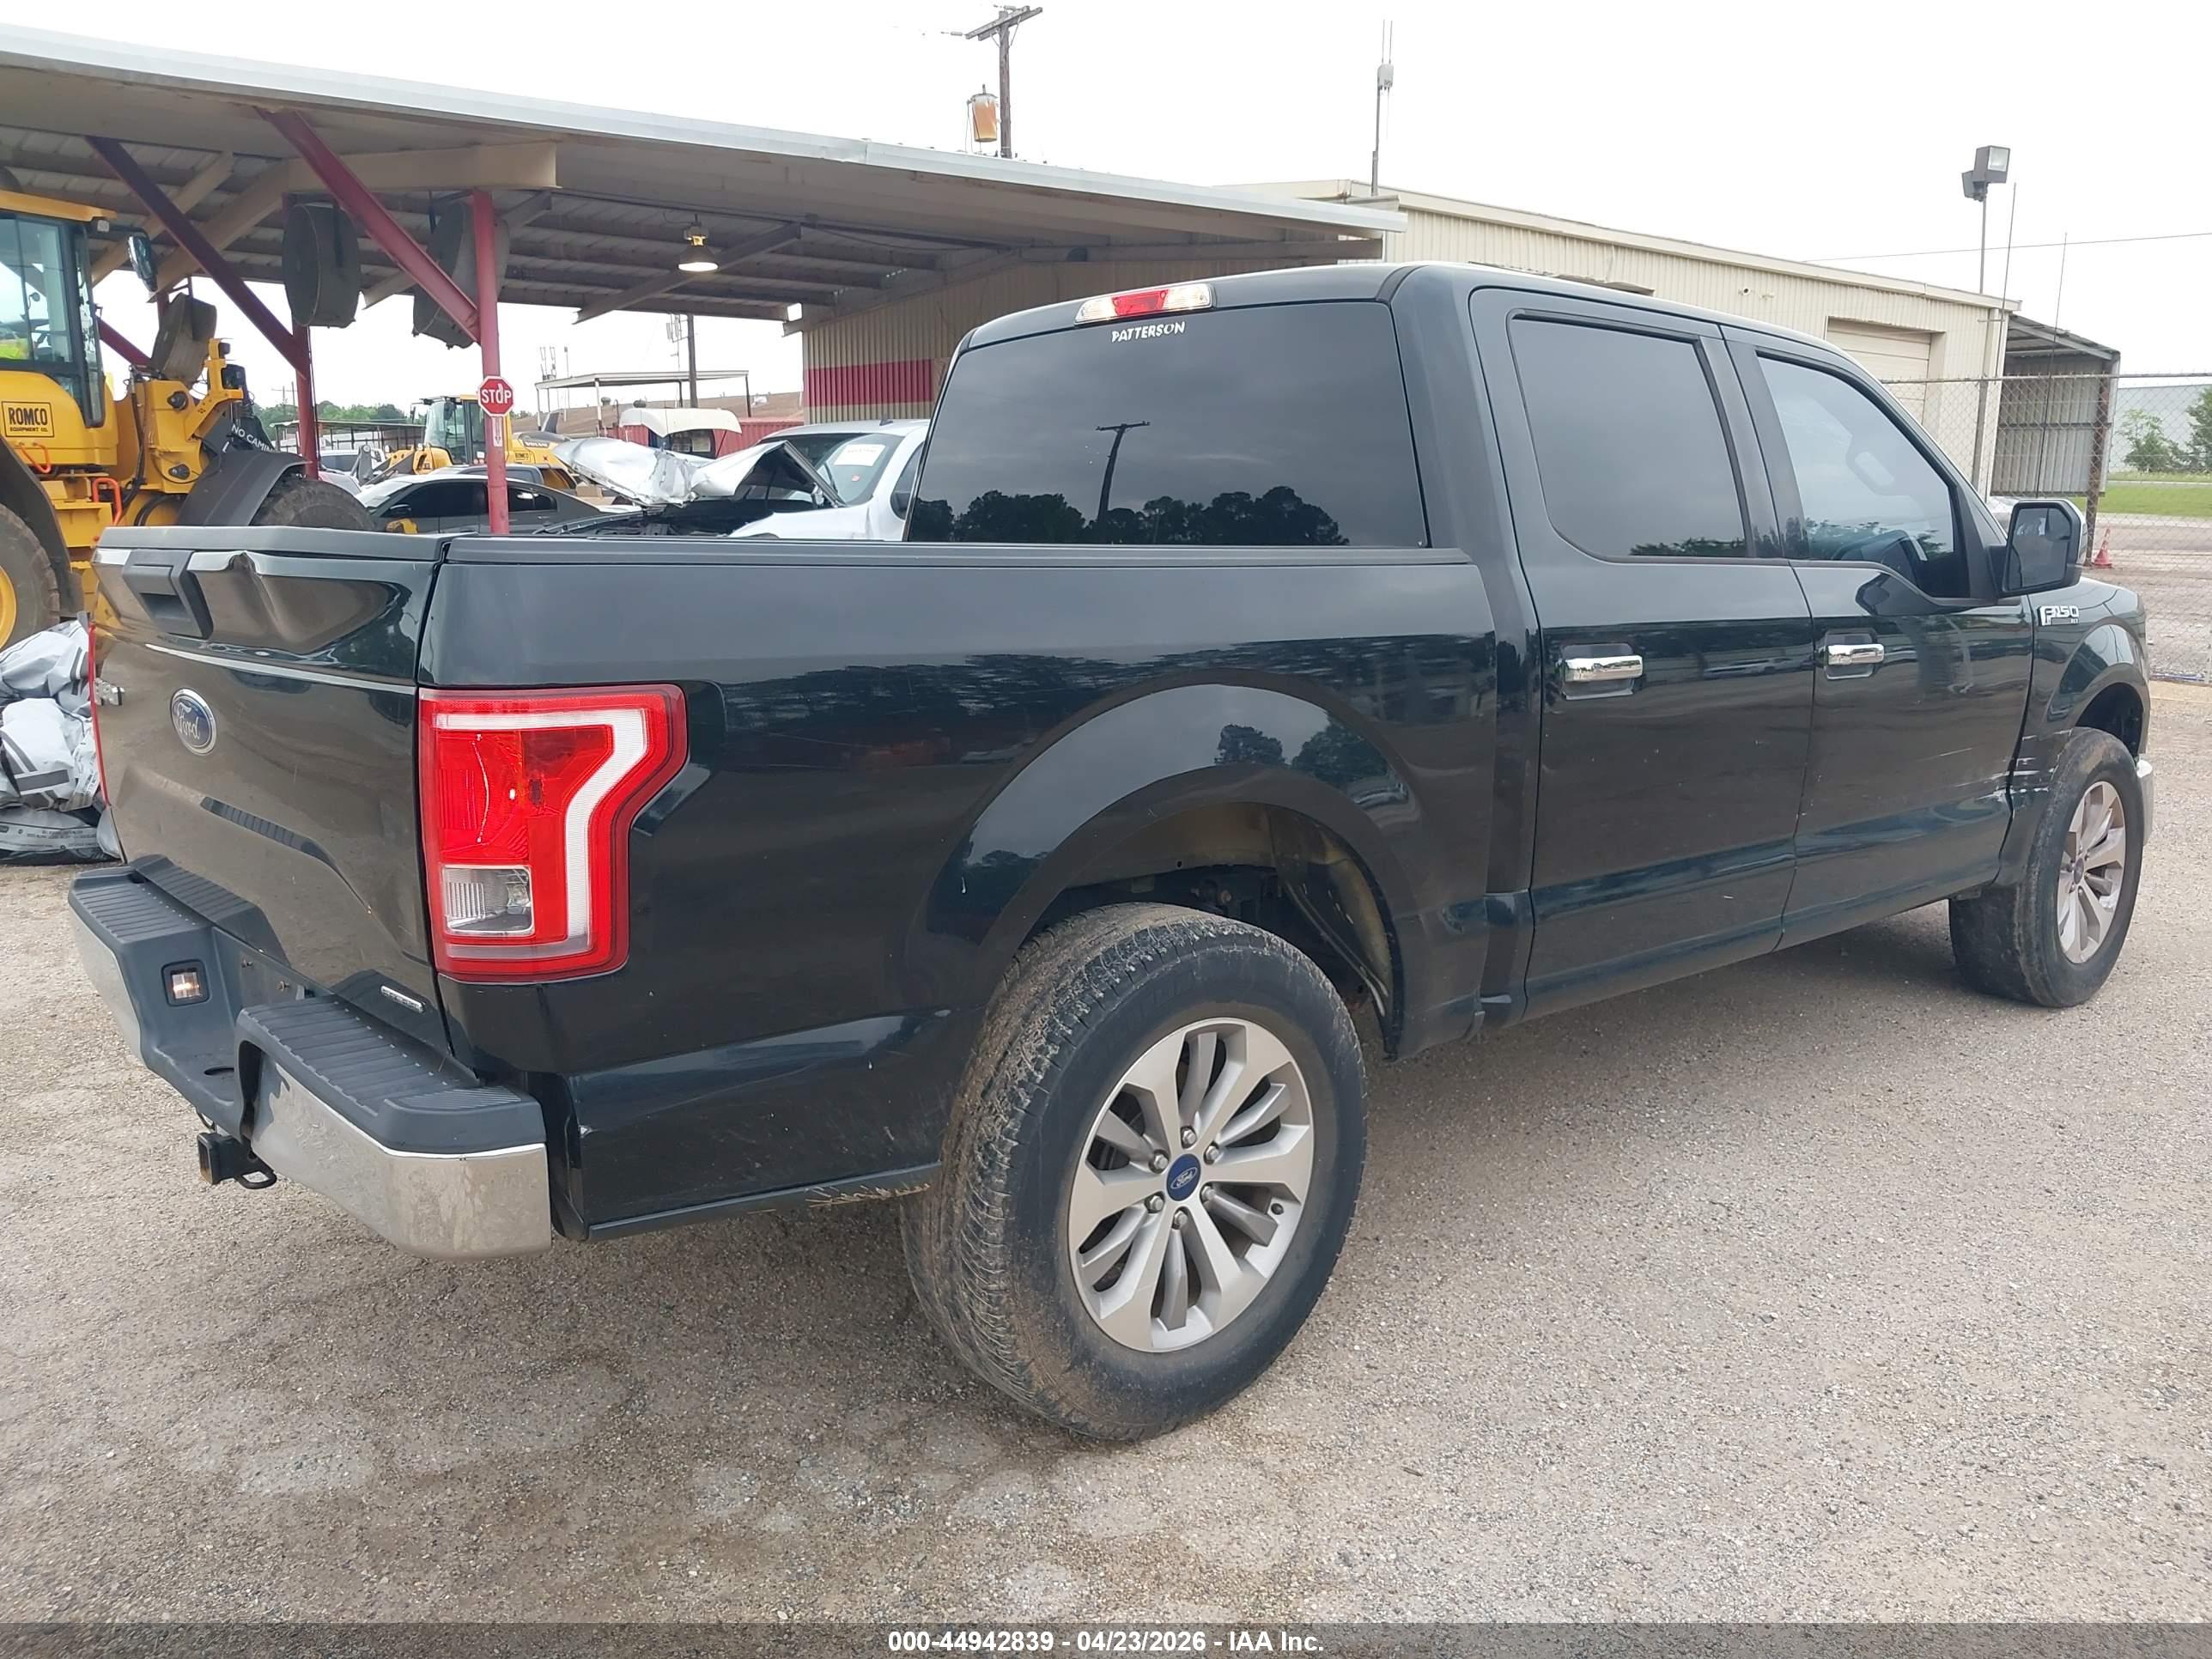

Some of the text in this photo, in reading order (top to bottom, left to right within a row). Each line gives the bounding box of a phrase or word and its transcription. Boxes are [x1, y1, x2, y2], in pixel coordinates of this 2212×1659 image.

[1111, 320, 1186, 343] PATTERSON
[481, 386, 512, 404] STOP
[8, 407, 48, 426] ROMCO
[231, 423, 246, 437] NO
[176, 702, 202, 740] Ford
